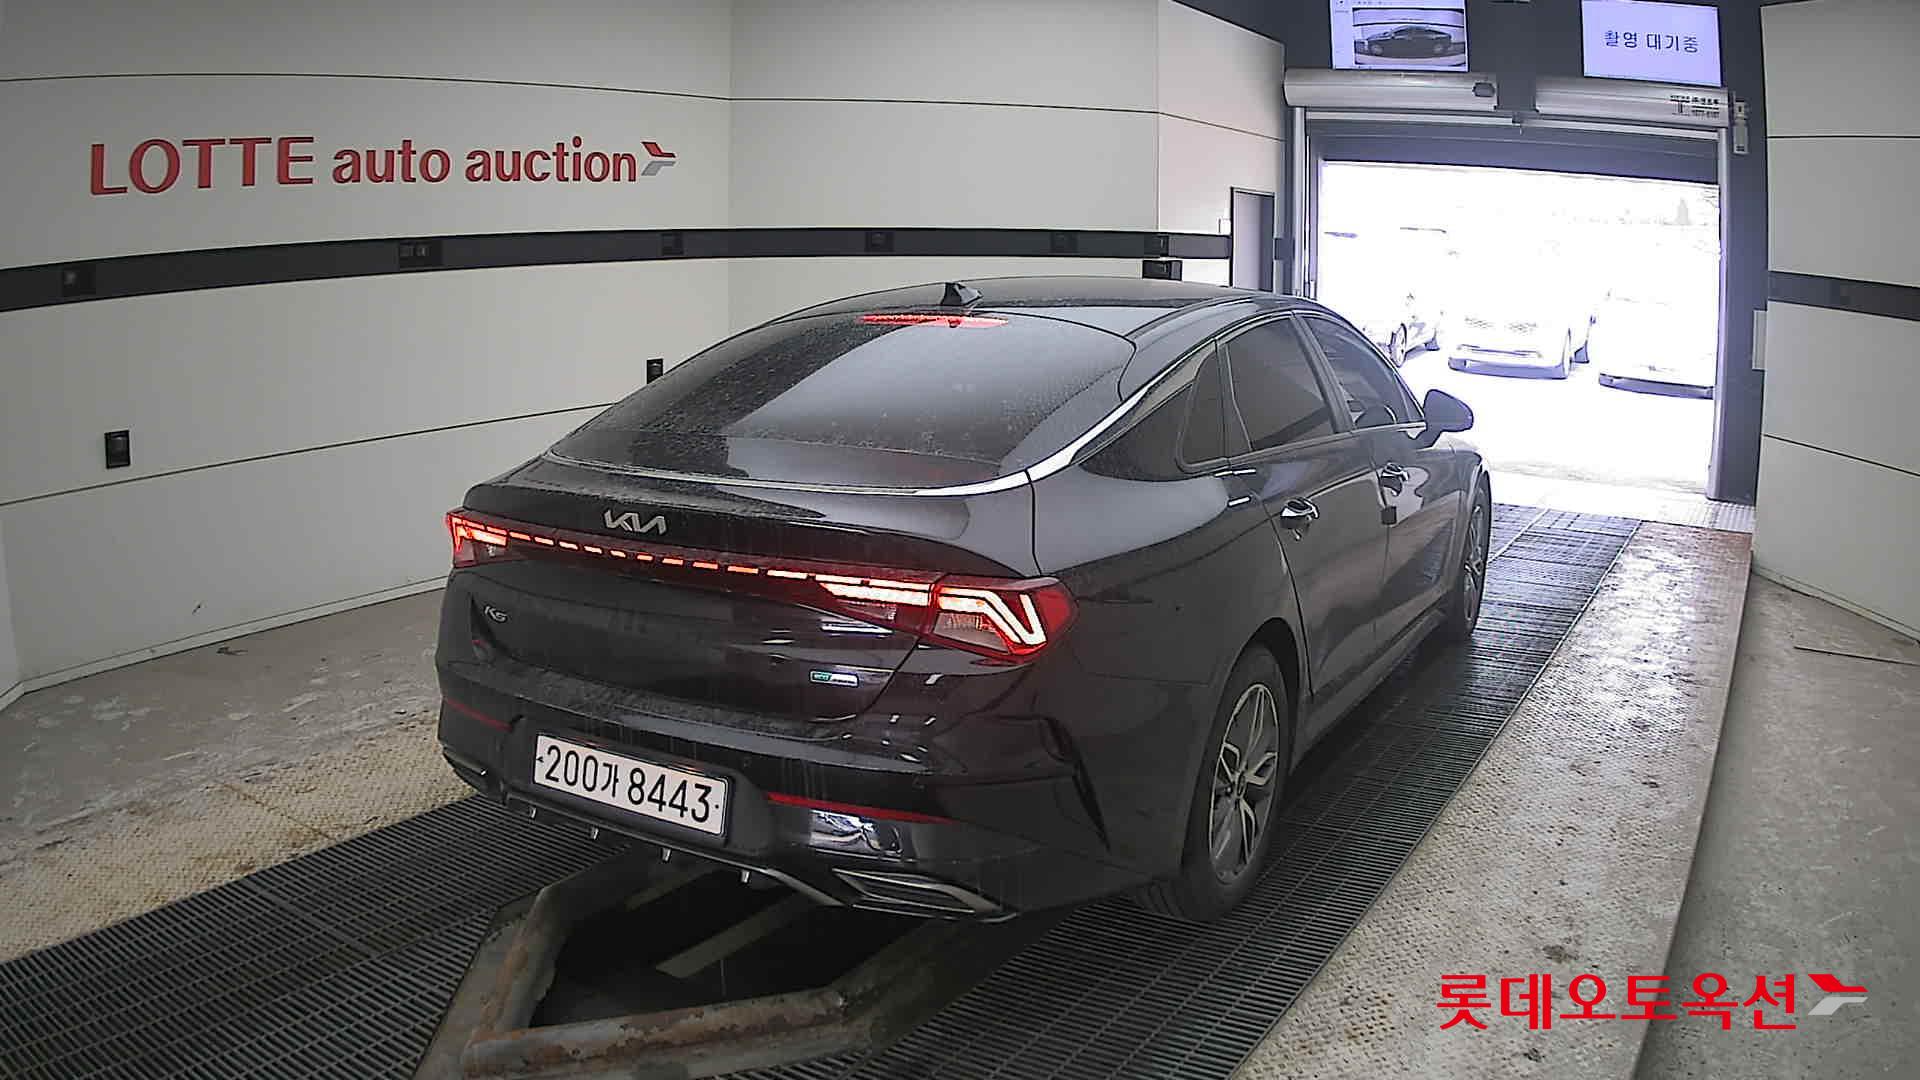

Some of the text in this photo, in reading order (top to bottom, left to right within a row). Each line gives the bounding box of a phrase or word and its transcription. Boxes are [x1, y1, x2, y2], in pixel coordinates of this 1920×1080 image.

[1604, 30, 1699, 53] 촬영 대기중
[91, 136, 637, 195] LOTTE auto auction
[604, 510, 667, 535] KIA
[545, 745, 713, 823] 200가 8443
